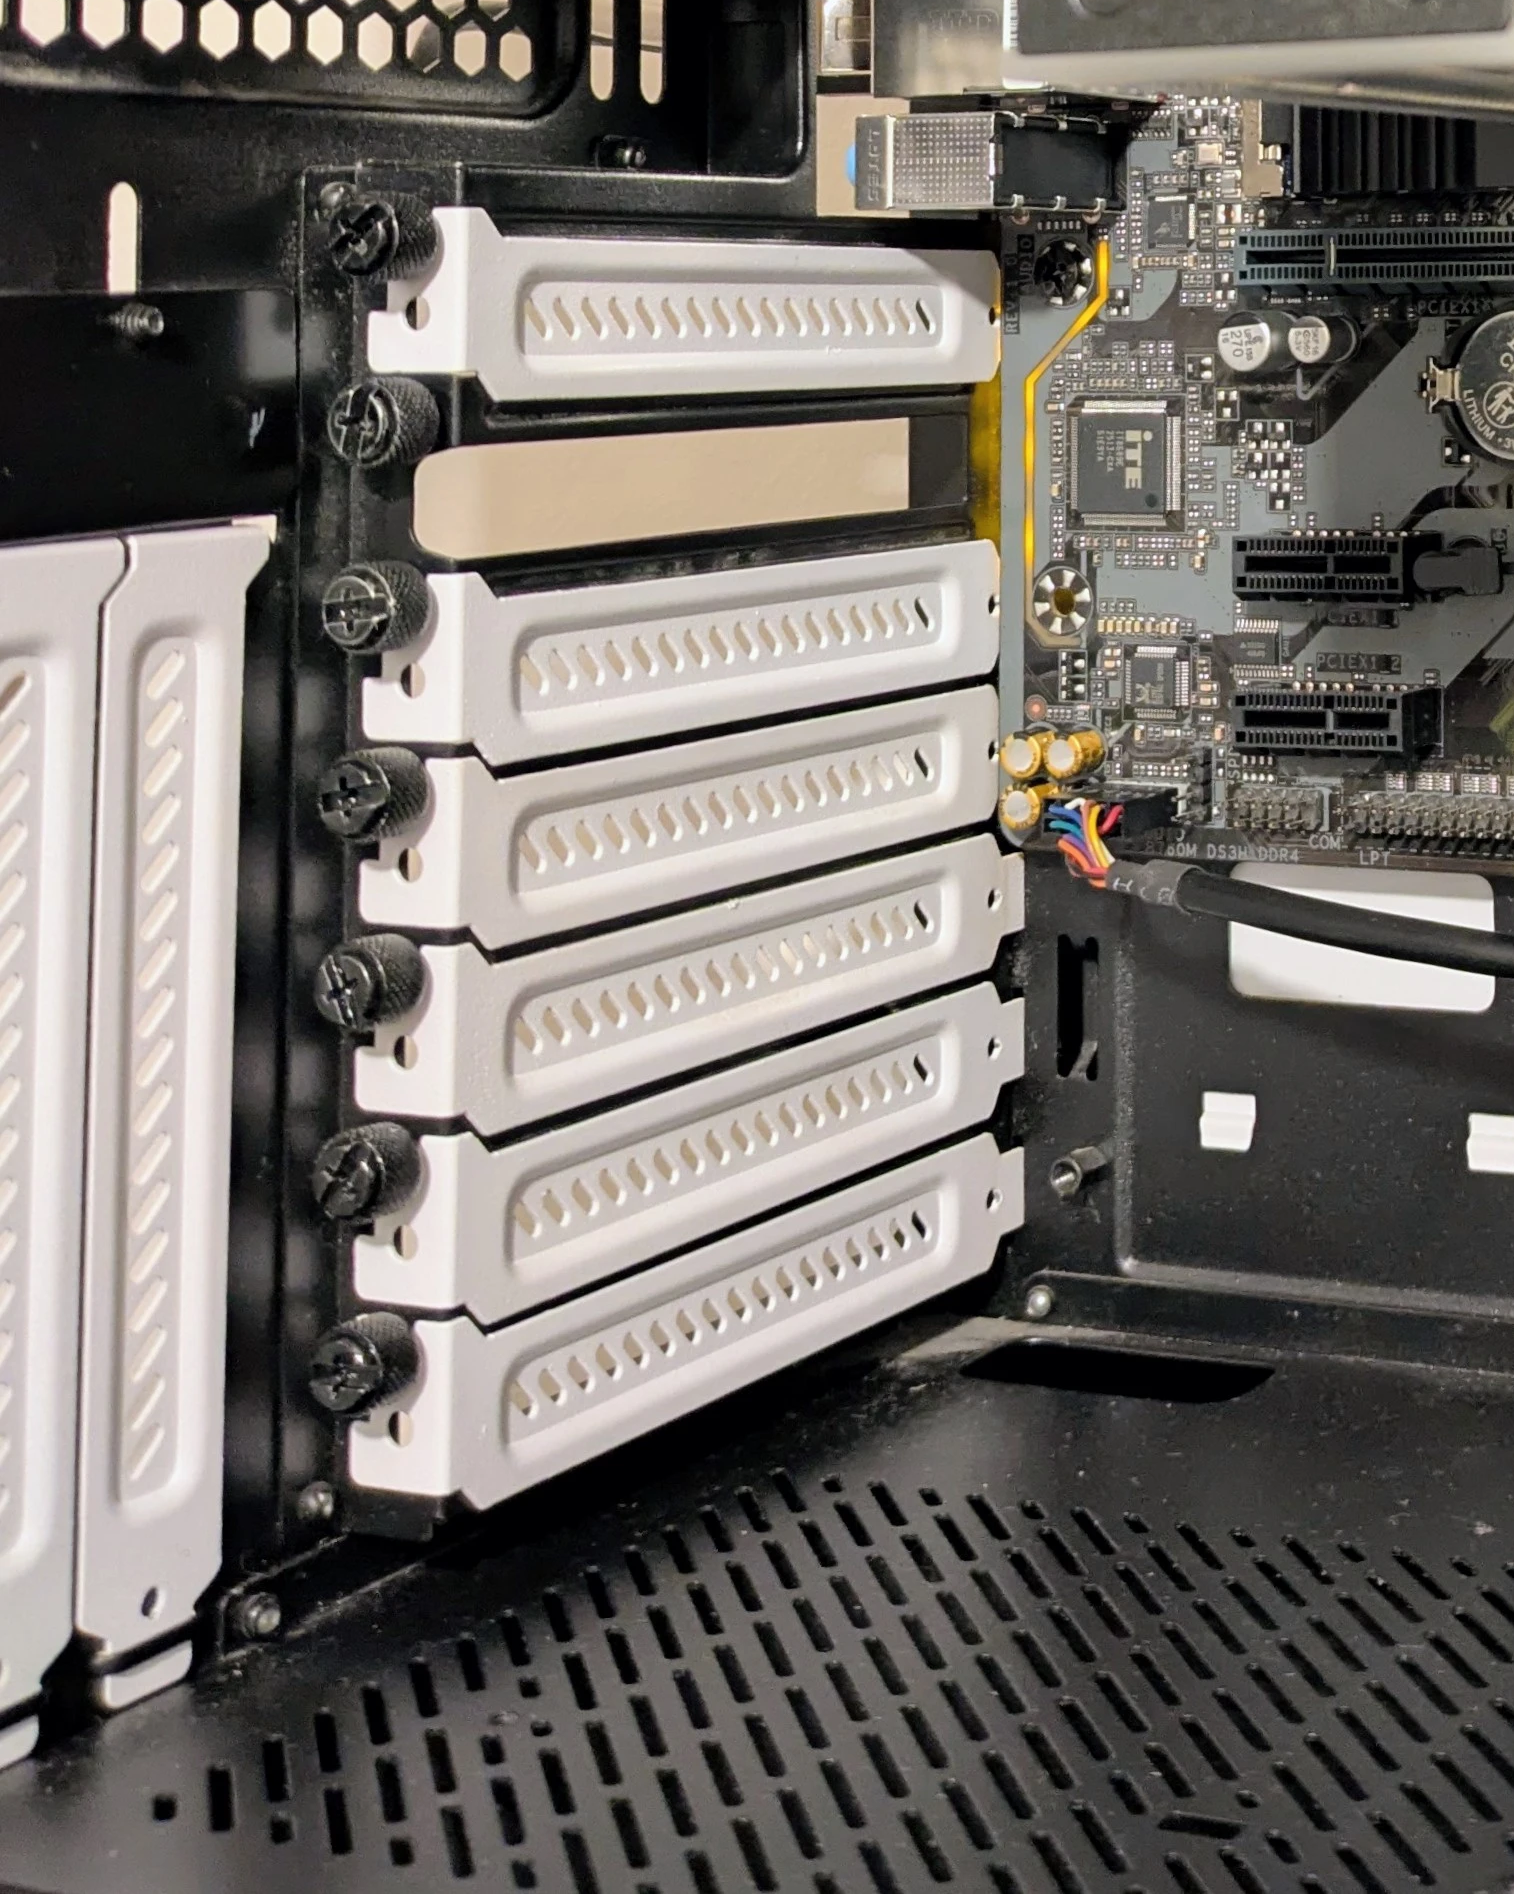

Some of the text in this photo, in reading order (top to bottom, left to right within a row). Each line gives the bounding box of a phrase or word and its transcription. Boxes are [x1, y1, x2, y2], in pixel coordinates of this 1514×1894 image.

[1230, 329, 1244, 358] 270
[1462, 388, 1497, 441] LITHIUM
[1317, 654, 1400, 674] PCIEX1_2
[1308, 835, 1341, 850] COM
[1207, 844, 1248, 860] DS3H
[1258, 846, 1300, 862] DDR4
[1359, 850, 1391, 866] LPT
